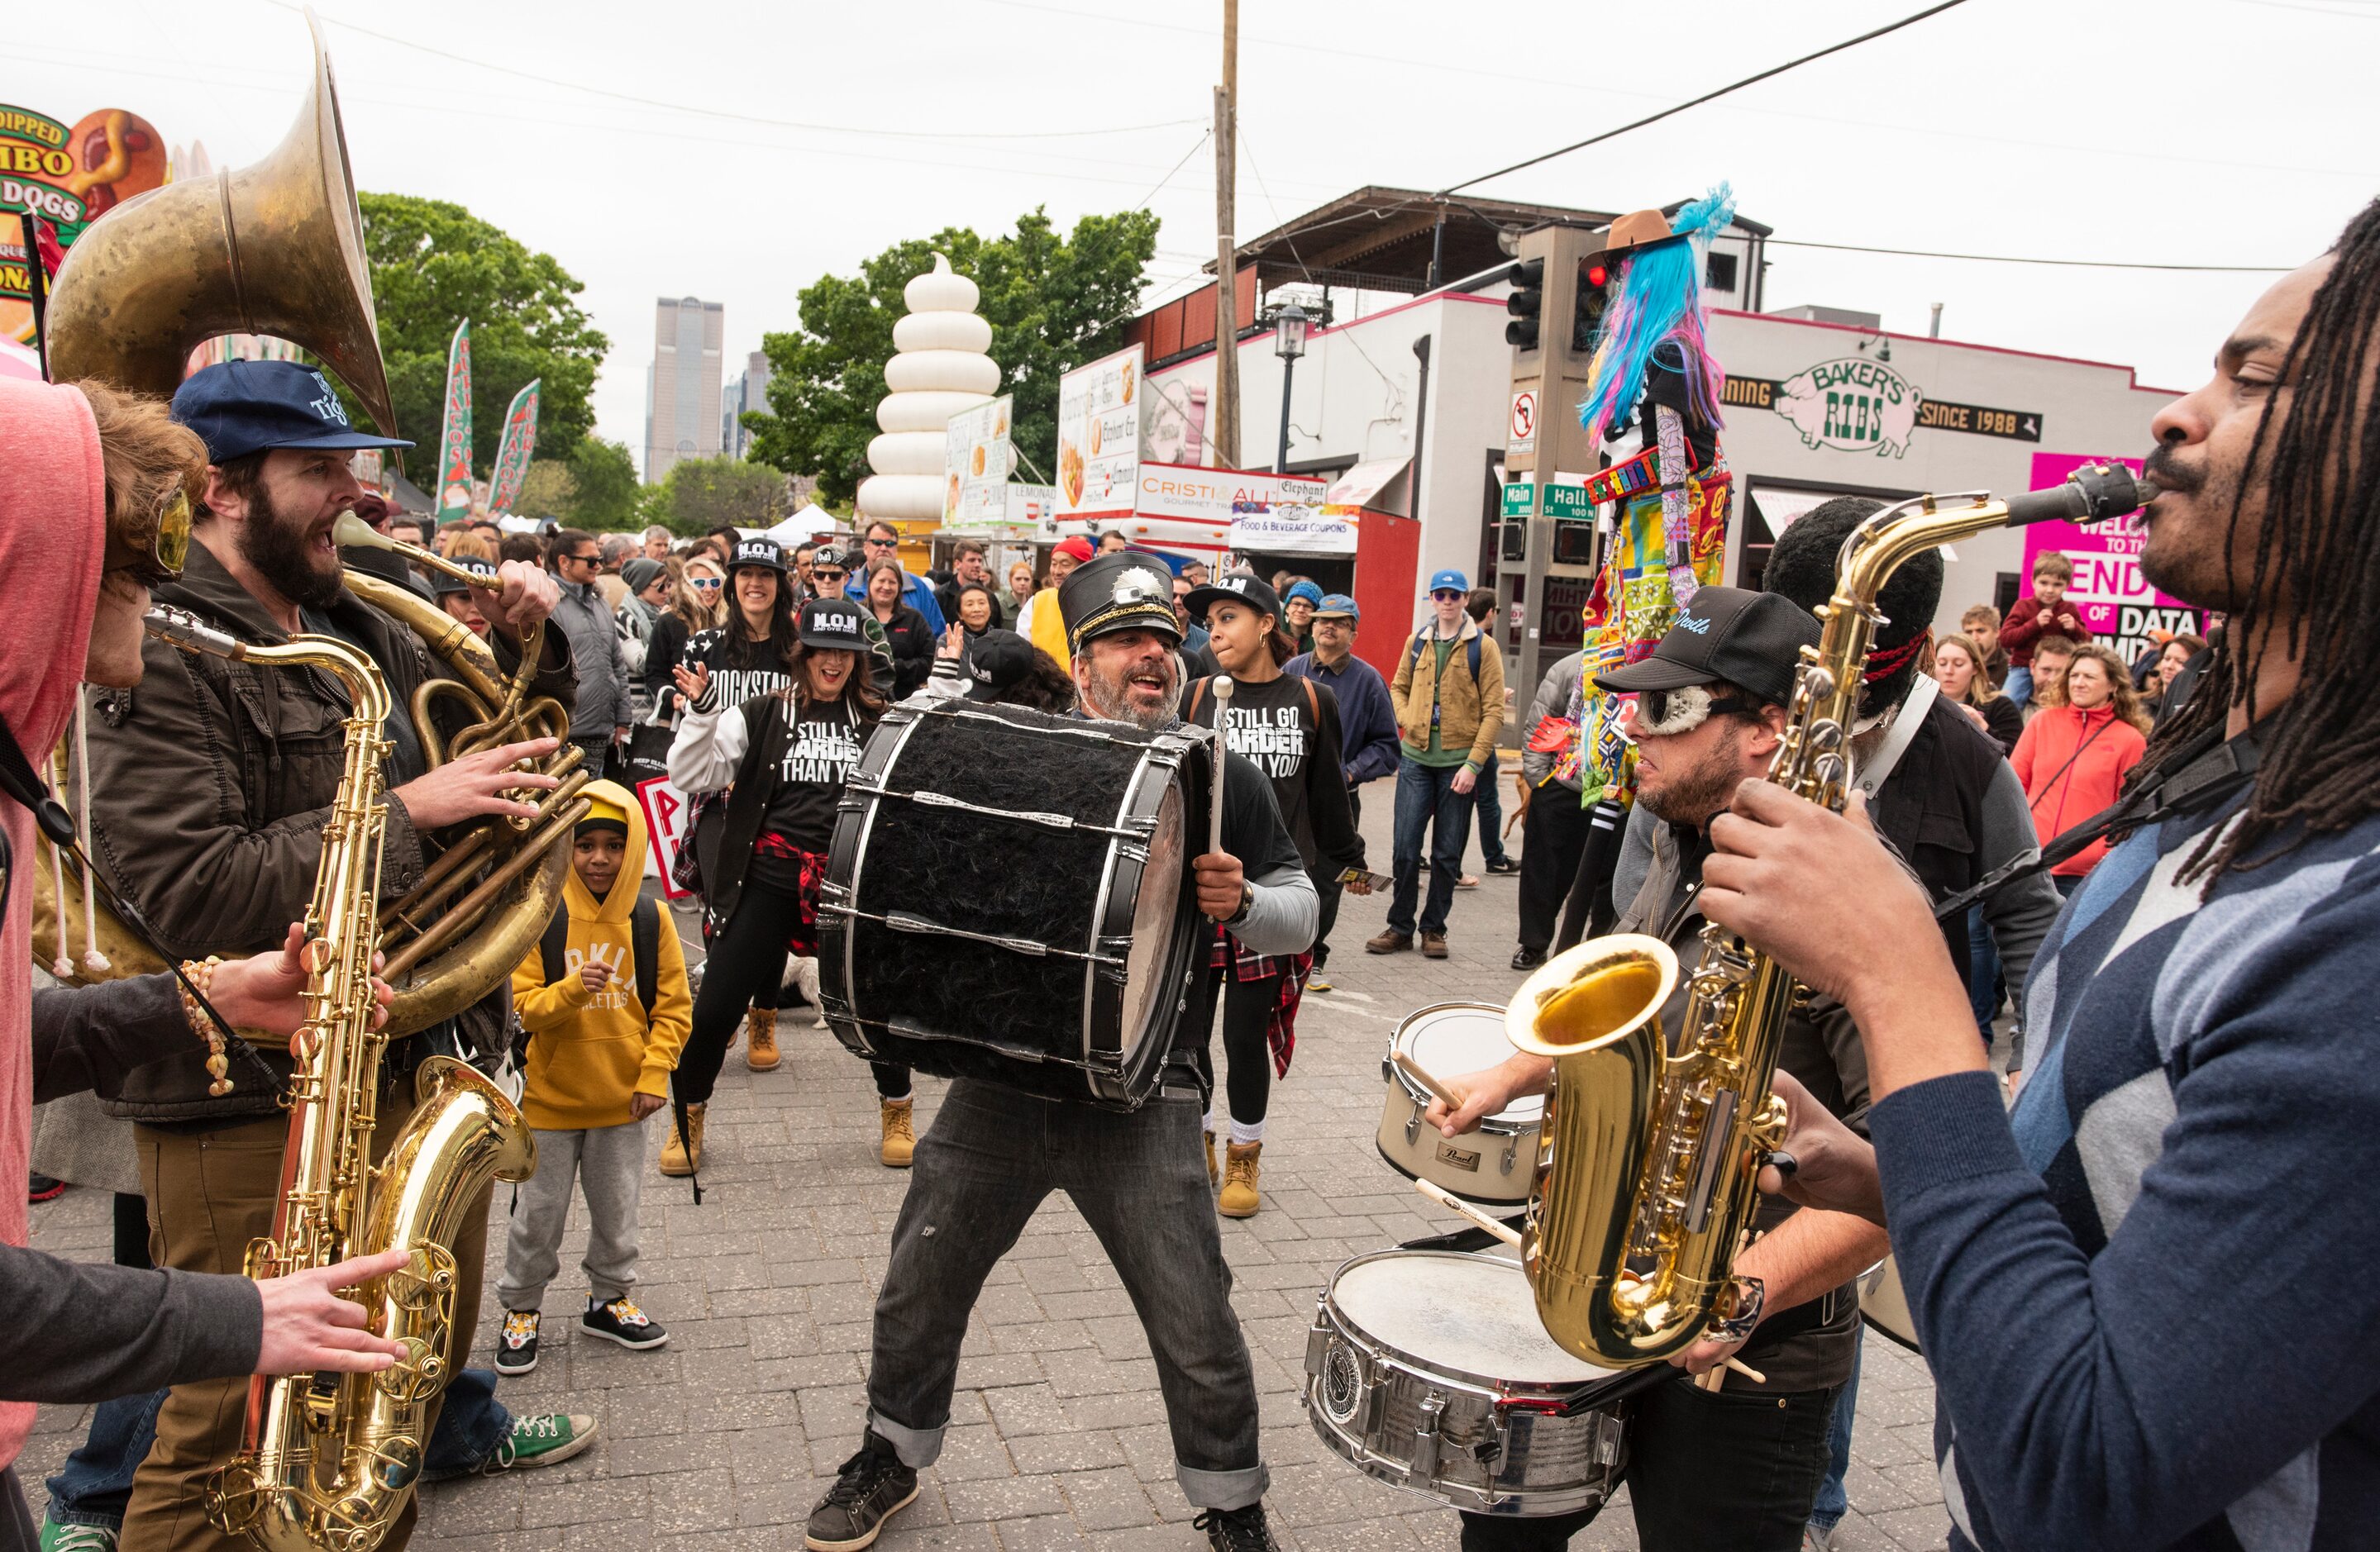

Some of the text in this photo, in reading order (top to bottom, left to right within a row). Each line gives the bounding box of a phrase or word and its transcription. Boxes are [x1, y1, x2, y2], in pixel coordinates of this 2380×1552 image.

[2, 179, 80, 222] DOGS
[1812, 362, 1905, 405] BAKER'S
[1722, 378, 2017, 435] NING SINCE 1988
[1824, 392, 1883, 442] RIBS
[499, 423, 524, 493] TACOS
[1142, 478, 1215, 499] CRISTI
[1281, 481, 1324, 496] Elephant
[1507, 487, 1529, 502] Main
[1555, 489, 1586, 506] Hall
[1164, 497, 1210, 509] GOURMET
[1545, 506, 1553, 514] St
[1572, 507, 1586, 517] 100
[1241, 521, 1347, 533] FOOD & BEVERAGE COUPONS
[2078, 516, 2149, 537] WELC
[2106, 537, 2126, 552] TO
[2069, 559, 2149, 597] END
[2089, 606, 2196, 636] OF DATA
[1225, 707, 1273, 729] STILL
[1277, 707, 1299, 729] GO
[797, 721, 842, 740] STILL
[1219, 727, 1304, 755] ARDER
[781, 759, 831, 783] THAN
[1267, 755, 1300, 778] YOU
[1442, 1148, 1473, 1164] Pearl
